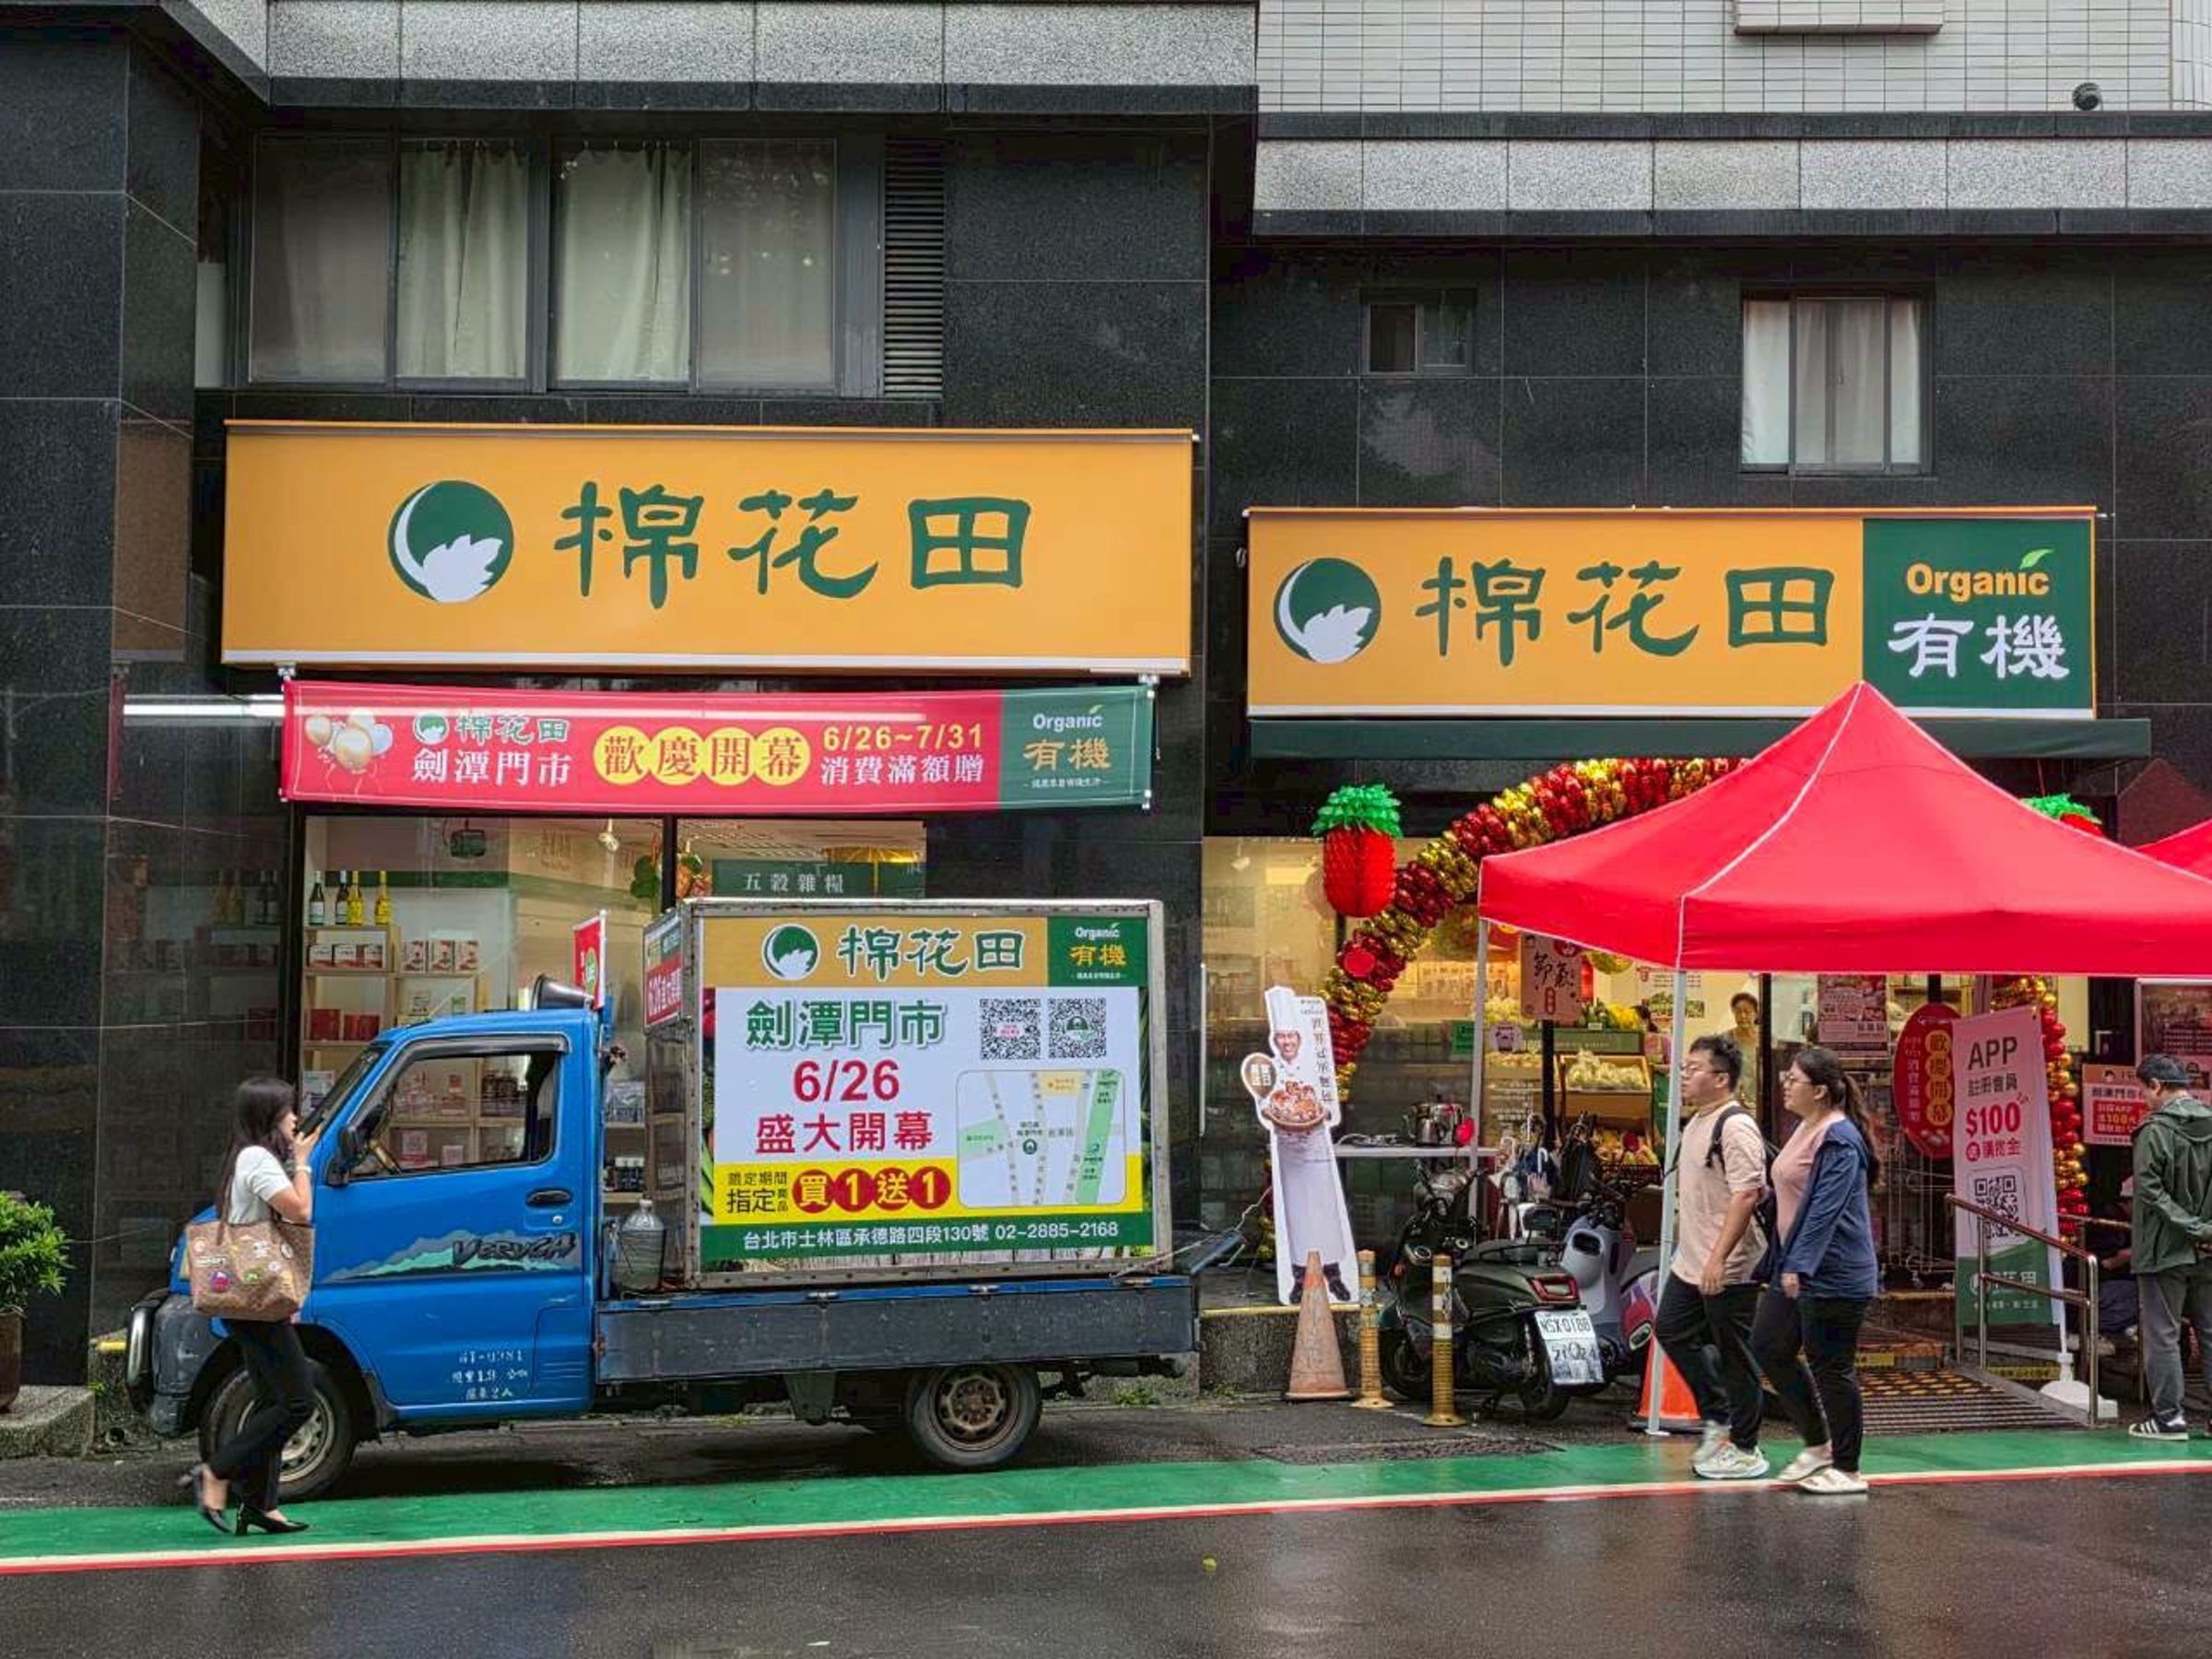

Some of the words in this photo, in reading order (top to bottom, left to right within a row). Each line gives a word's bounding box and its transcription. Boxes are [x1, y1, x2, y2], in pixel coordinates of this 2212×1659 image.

[554, 481, 1030, 609] 棉花田
[1906, 555, 2051, 603] Organic
[1415, 556, 1835, 666] 棉花田
[1888, 613, 2070, 679] 有機
[455, 712, 570, 743] 棉花田
[823, 723, 983, 752] 6/26~7/31
[1032, 709, 1103, 730] Organic
[411, 747, 573, 787] 劍潭門市
[604, 735, 802, 779] 歡慶開幕
[819, 753, 984, 786] 消費滿額贈
[1021, 738, 1112, 771] 有機
[1074, 924, 1122, 941] Organic
[837, 924, 1025, 981] 棉花田
[1069, 944, 1127, 967] 有機
[746, 998, 947, 1050] 劍潭門市
[1968, 1036, 2018, 1071] APP
[793, 1059, 900, 1102] 6/26
[756, 1112, 933, 1155] 盛大開幕
[1965, 1101, 2021, 1137] $100
[726, 1188, 776, 1214] 指定
[799, 1171, 935, 1207] 買1送1
[743, 1222, 989, 1251] 台北市士林區承德路四段130號
[994, 1220, 1120, 1241] 02-2885-2168
